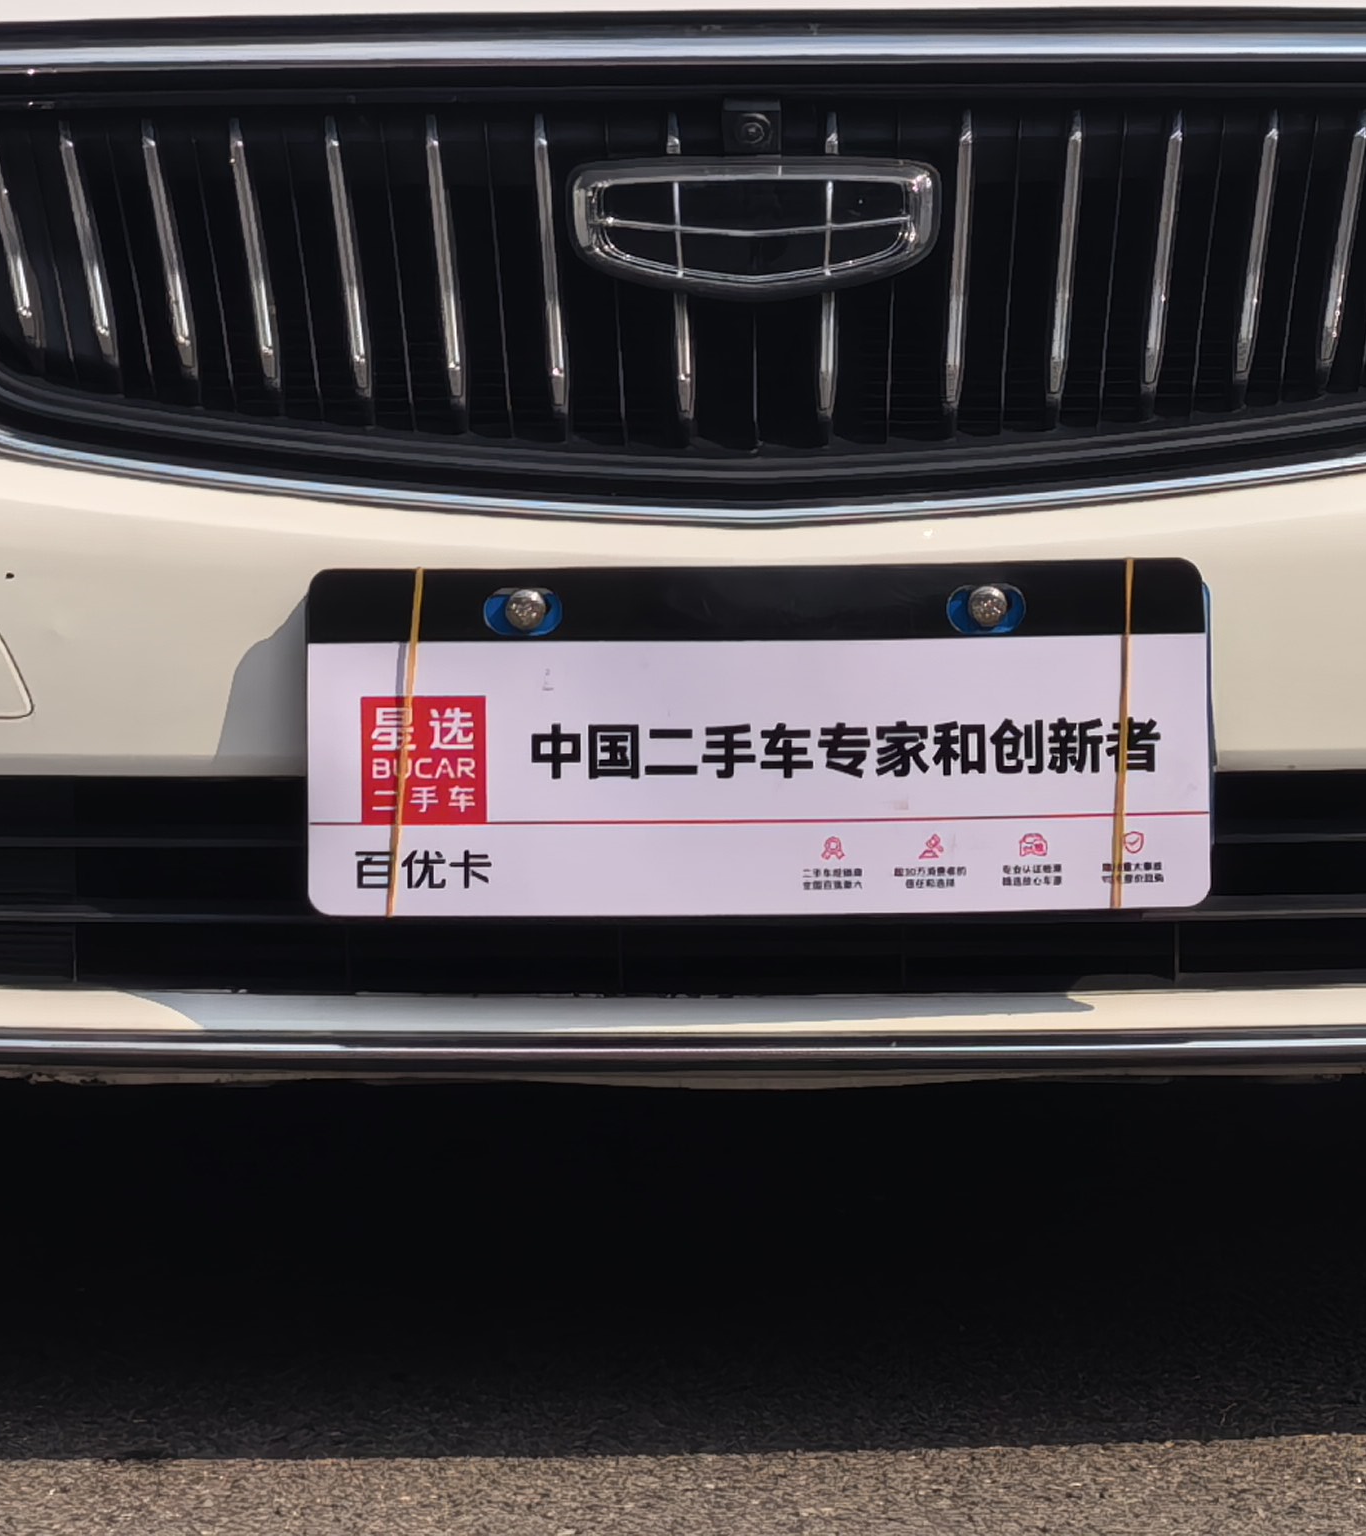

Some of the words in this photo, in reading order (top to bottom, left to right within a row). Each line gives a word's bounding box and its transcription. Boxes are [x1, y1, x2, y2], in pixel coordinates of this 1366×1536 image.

[371, 707, 474, 750] 星选
[531, 717, 1161, 780] 中国二手车专家和创新者
[372, 758, 476, 779] BUCAR
[372, 785, 476, 812] 二手车
[355, 850, 492, 889] 百优卡
